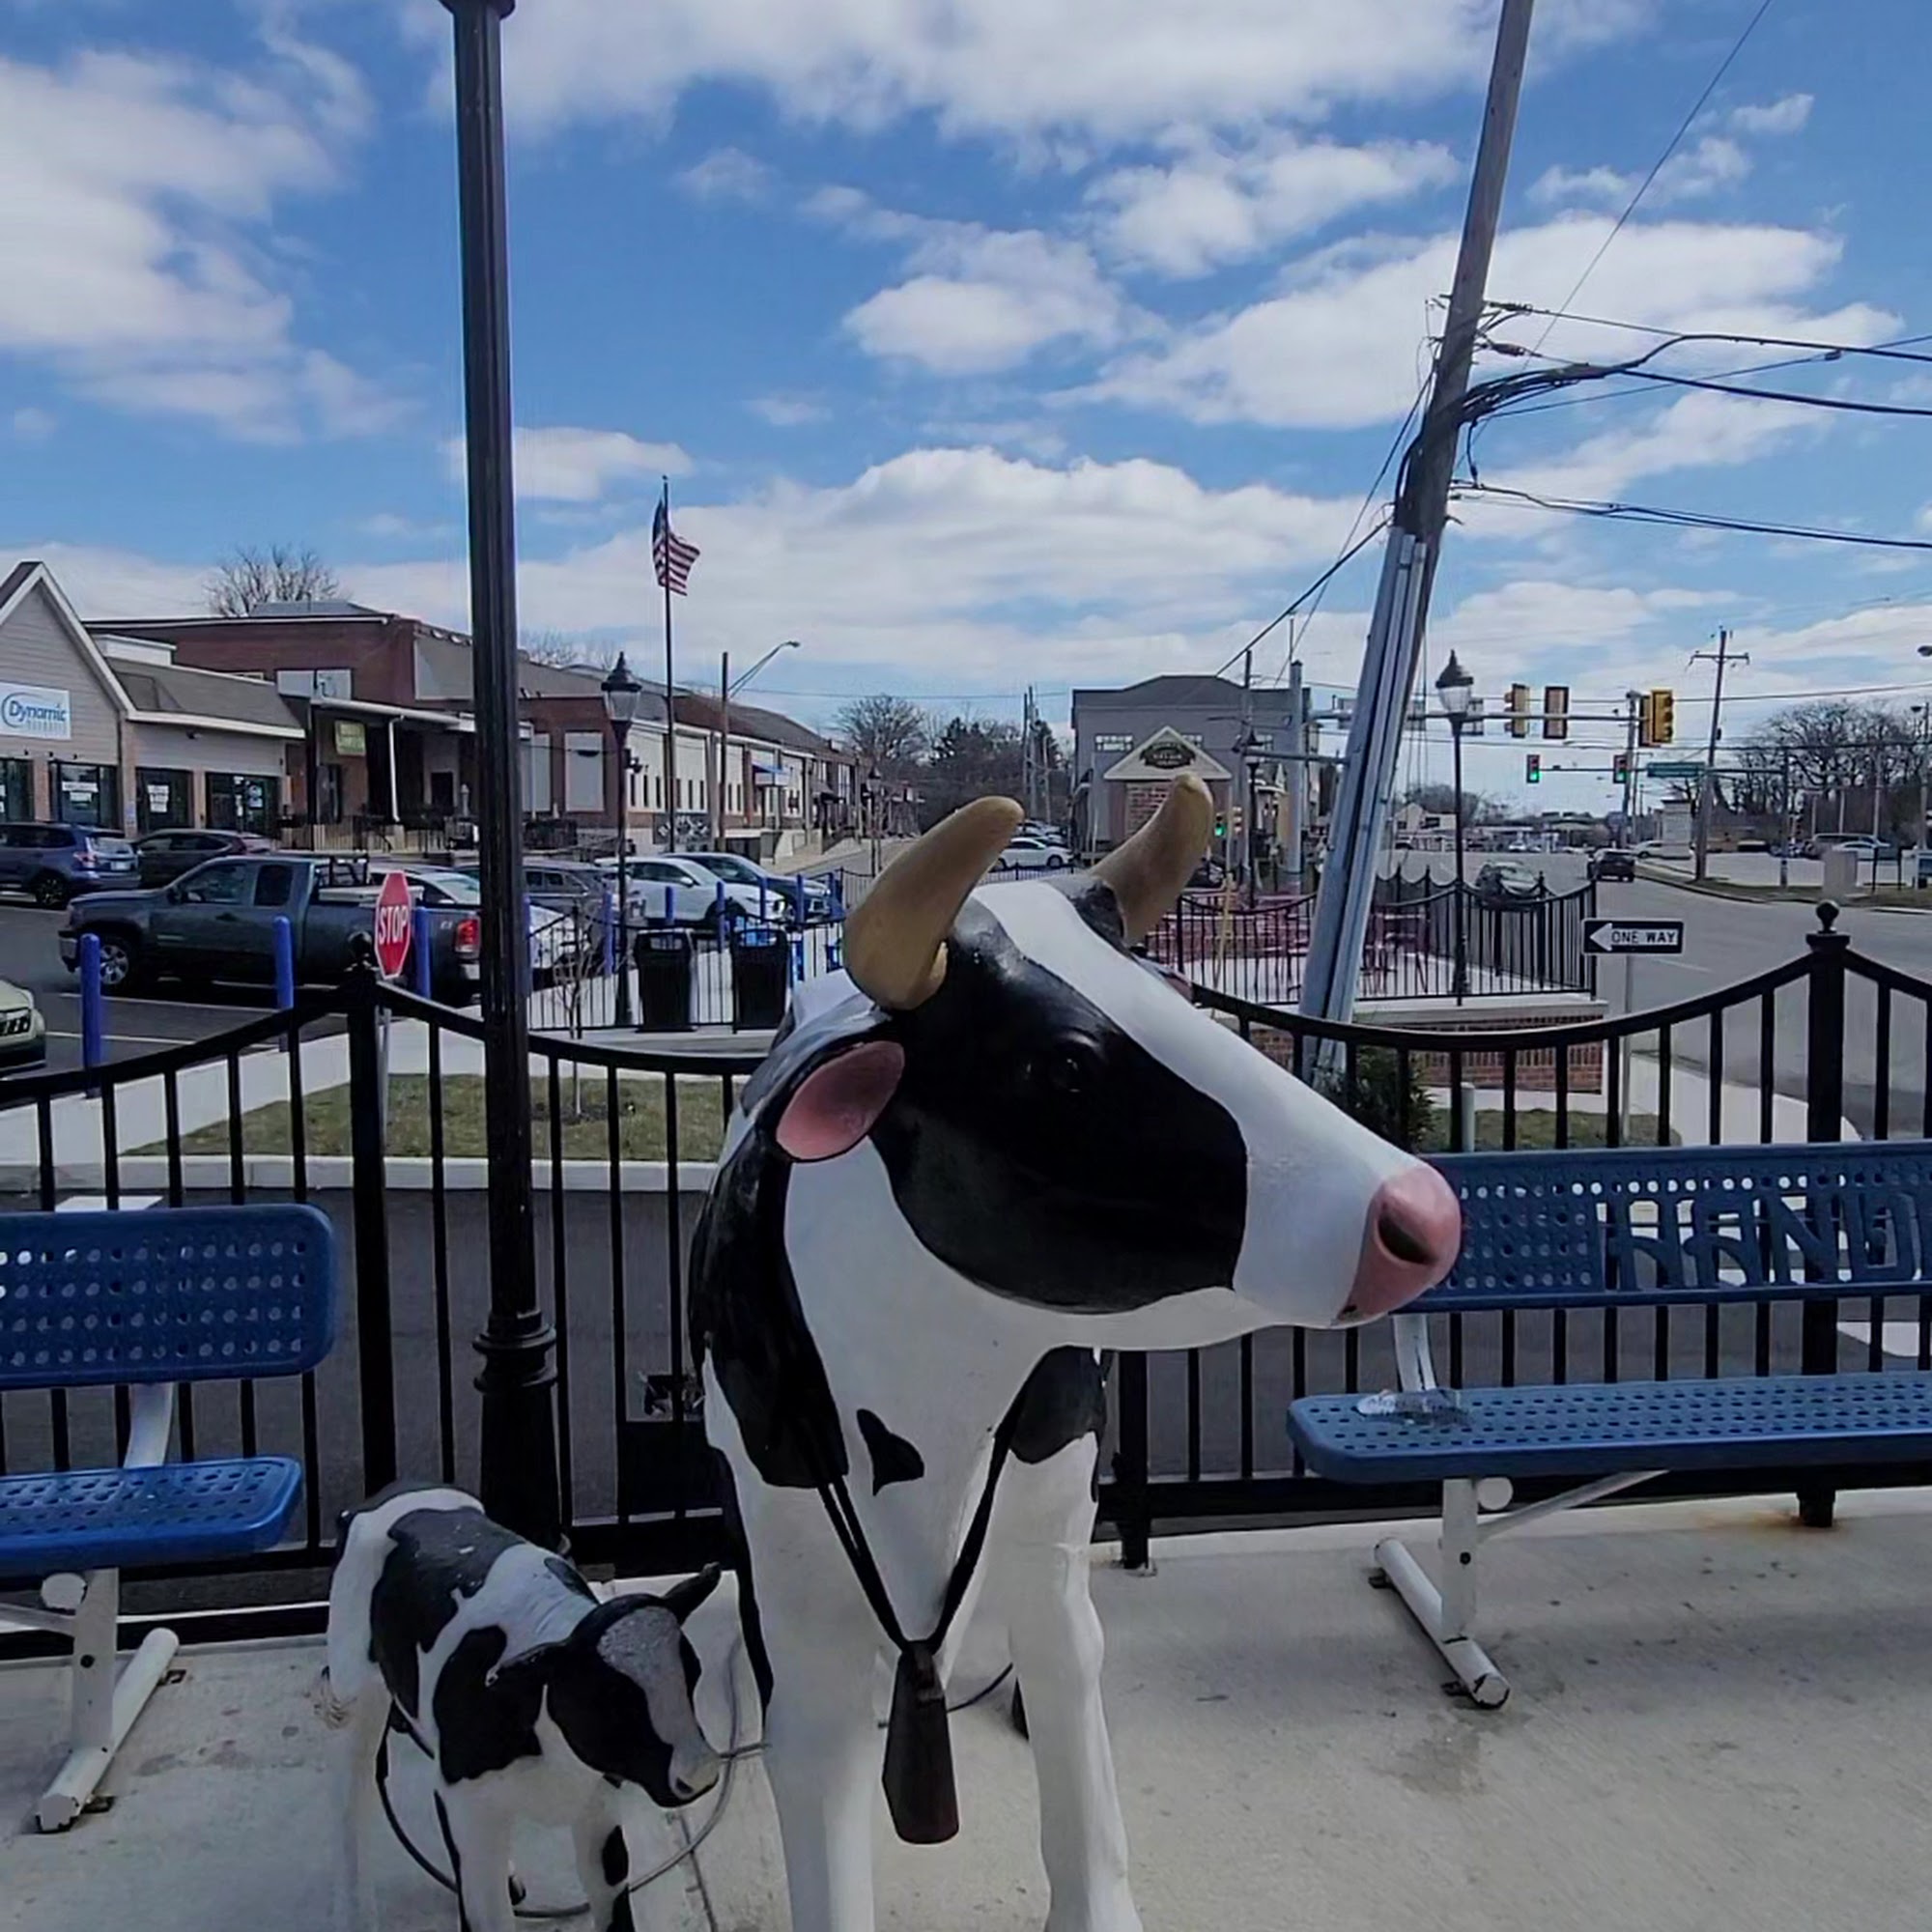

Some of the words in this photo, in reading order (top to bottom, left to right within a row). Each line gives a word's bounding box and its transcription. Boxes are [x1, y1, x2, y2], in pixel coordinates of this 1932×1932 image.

[9, 700, 66, 723] Dynamic
[379, 906, 409, 944] STOP
[1611, 930, 1639, 944] ONE
[1645, 931, 1676, 943] WAY
